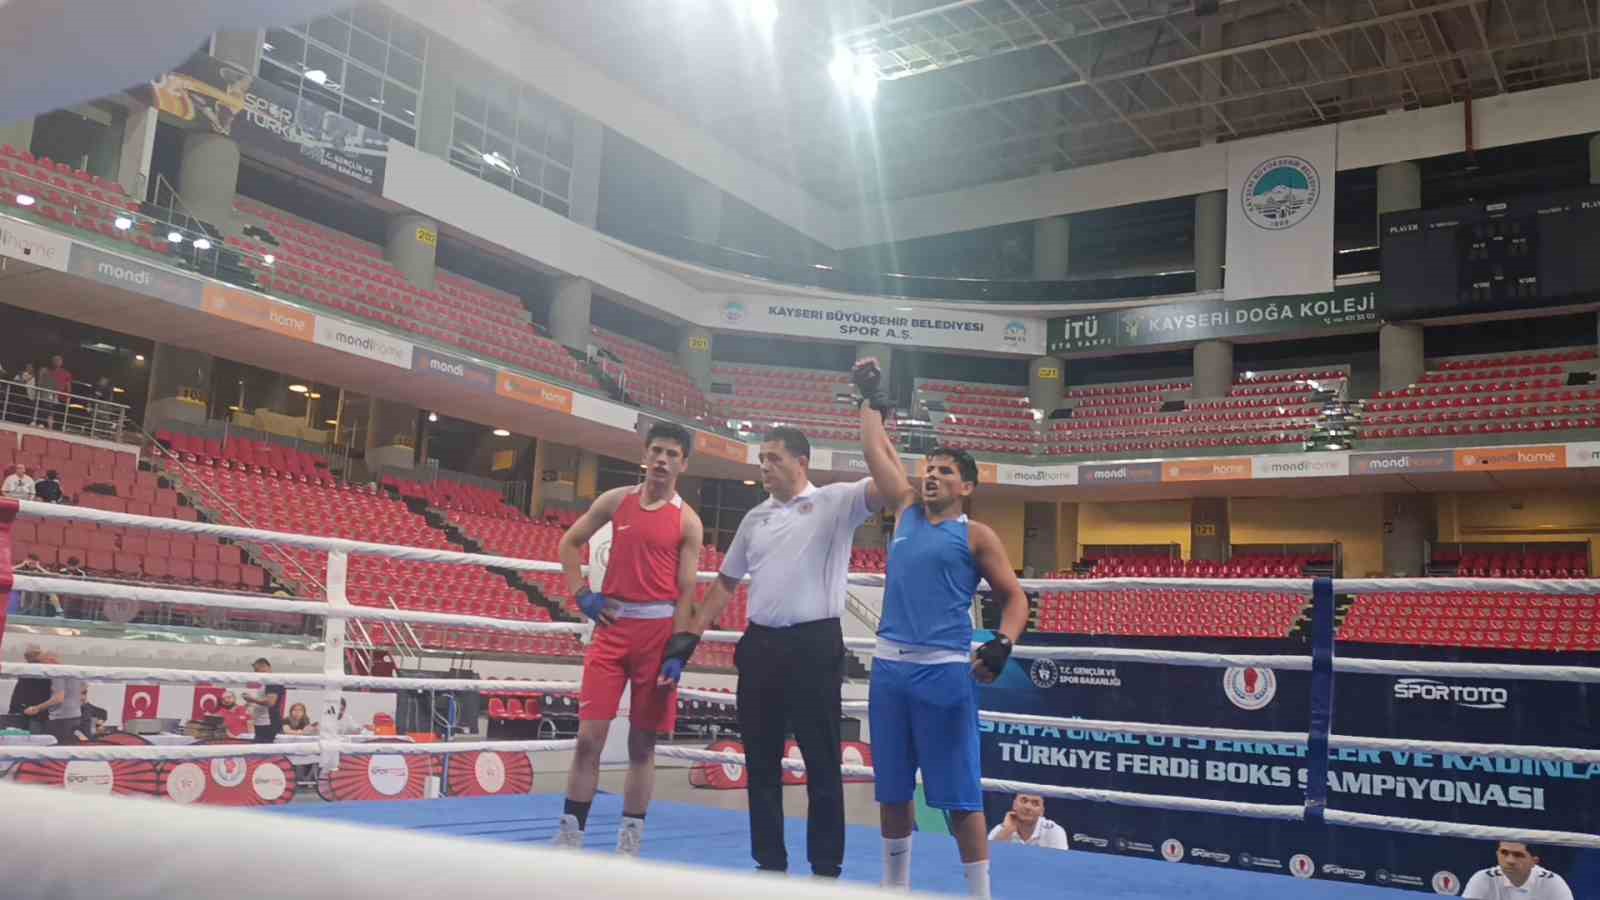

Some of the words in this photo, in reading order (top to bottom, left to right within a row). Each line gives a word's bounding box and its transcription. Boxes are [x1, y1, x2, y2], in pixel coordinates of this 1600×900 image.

[98, 262, 151, 285] mondi
[768, 306, 823, 320] KAYSERİ
[1149, 308, 1230, 332] KAYSERİ
[1236, 303, 1294, 324] DOĞA
[1300, 292, 1375, 318] KOLEJİ
[839, 324, 880, 338] SPOR
[1063, 315, 1099, 339] İTÜ
[429, 357, 464, 377] mondi
[1369, 456, 1409, 470] mondi
[1517, 451, 1557, 463] home
[1093, 466, 1127, 480] mondi
[1212, 463, 1245, 475] home
[1394, 682, 1508, 704] SPORTOTO
[1205, 761, 1292, 788] BOKS
